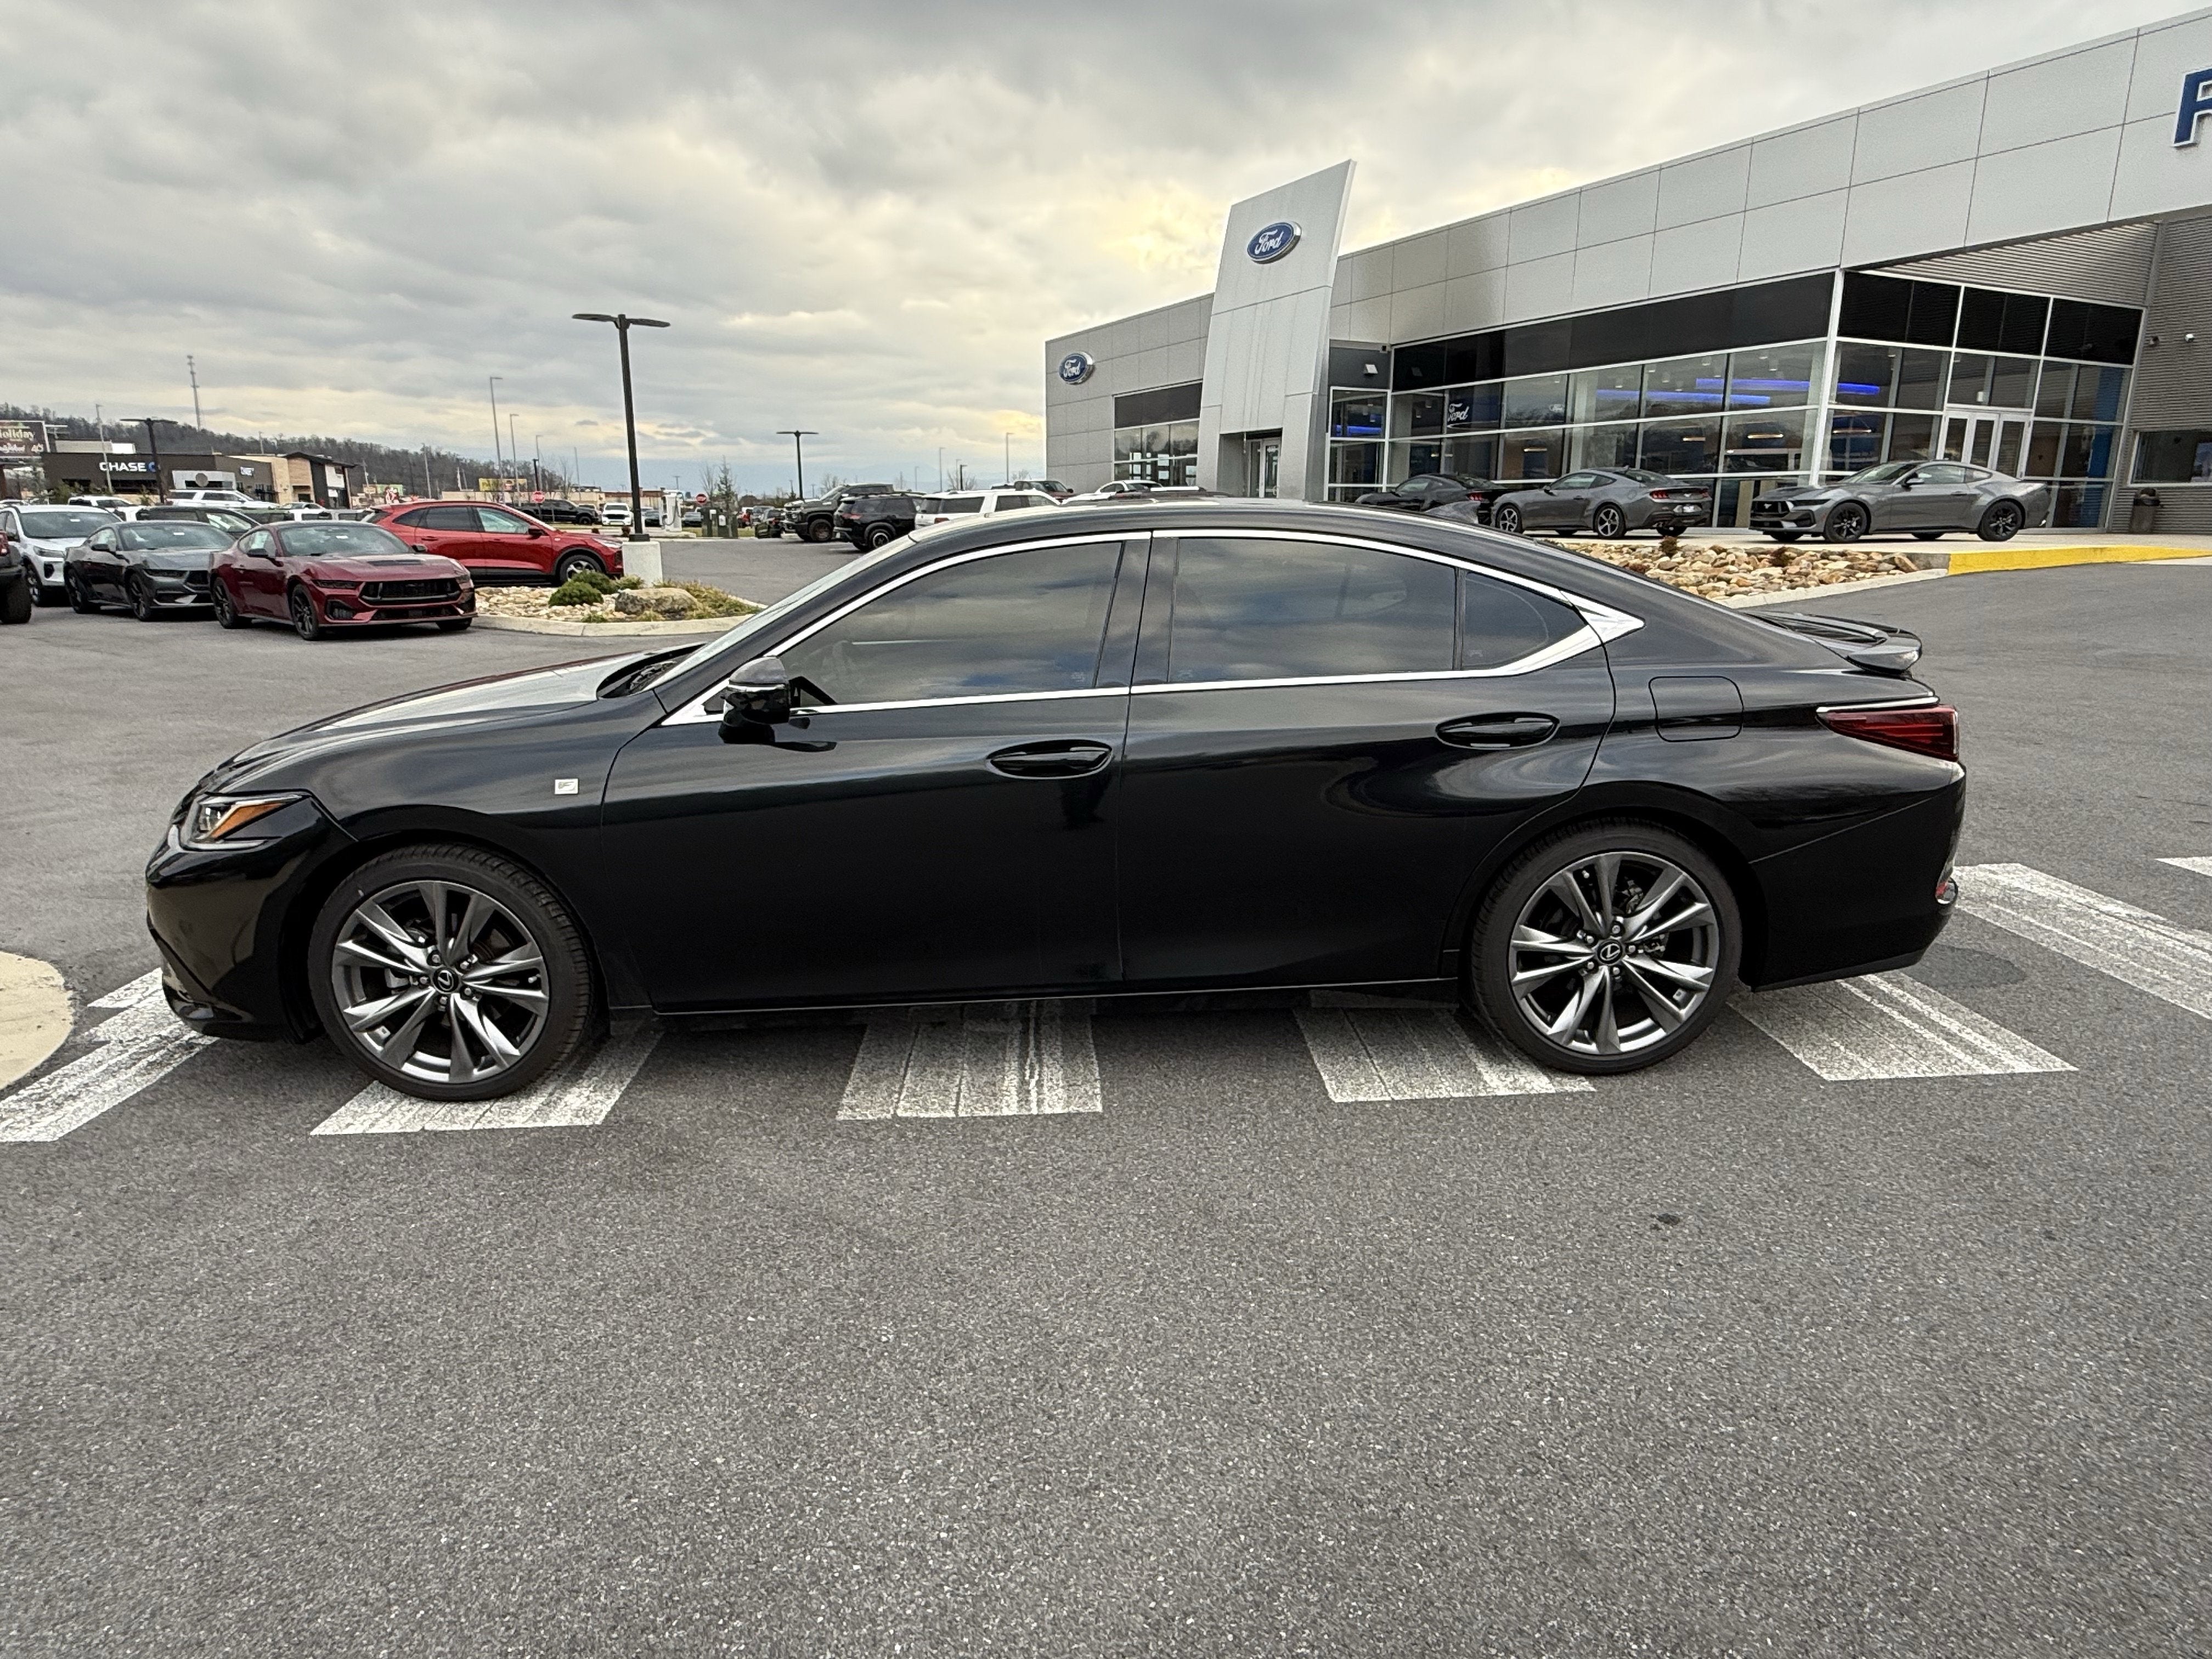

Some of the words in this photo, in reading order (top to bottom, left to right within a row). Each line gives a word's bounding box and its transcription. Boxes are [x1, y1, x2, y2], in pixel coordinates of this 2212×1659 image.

[1254, 229, 1284, 255] Ford
[1063, 359, 1081, 377] Ford
[99, 462, 147, 472] CHASE
